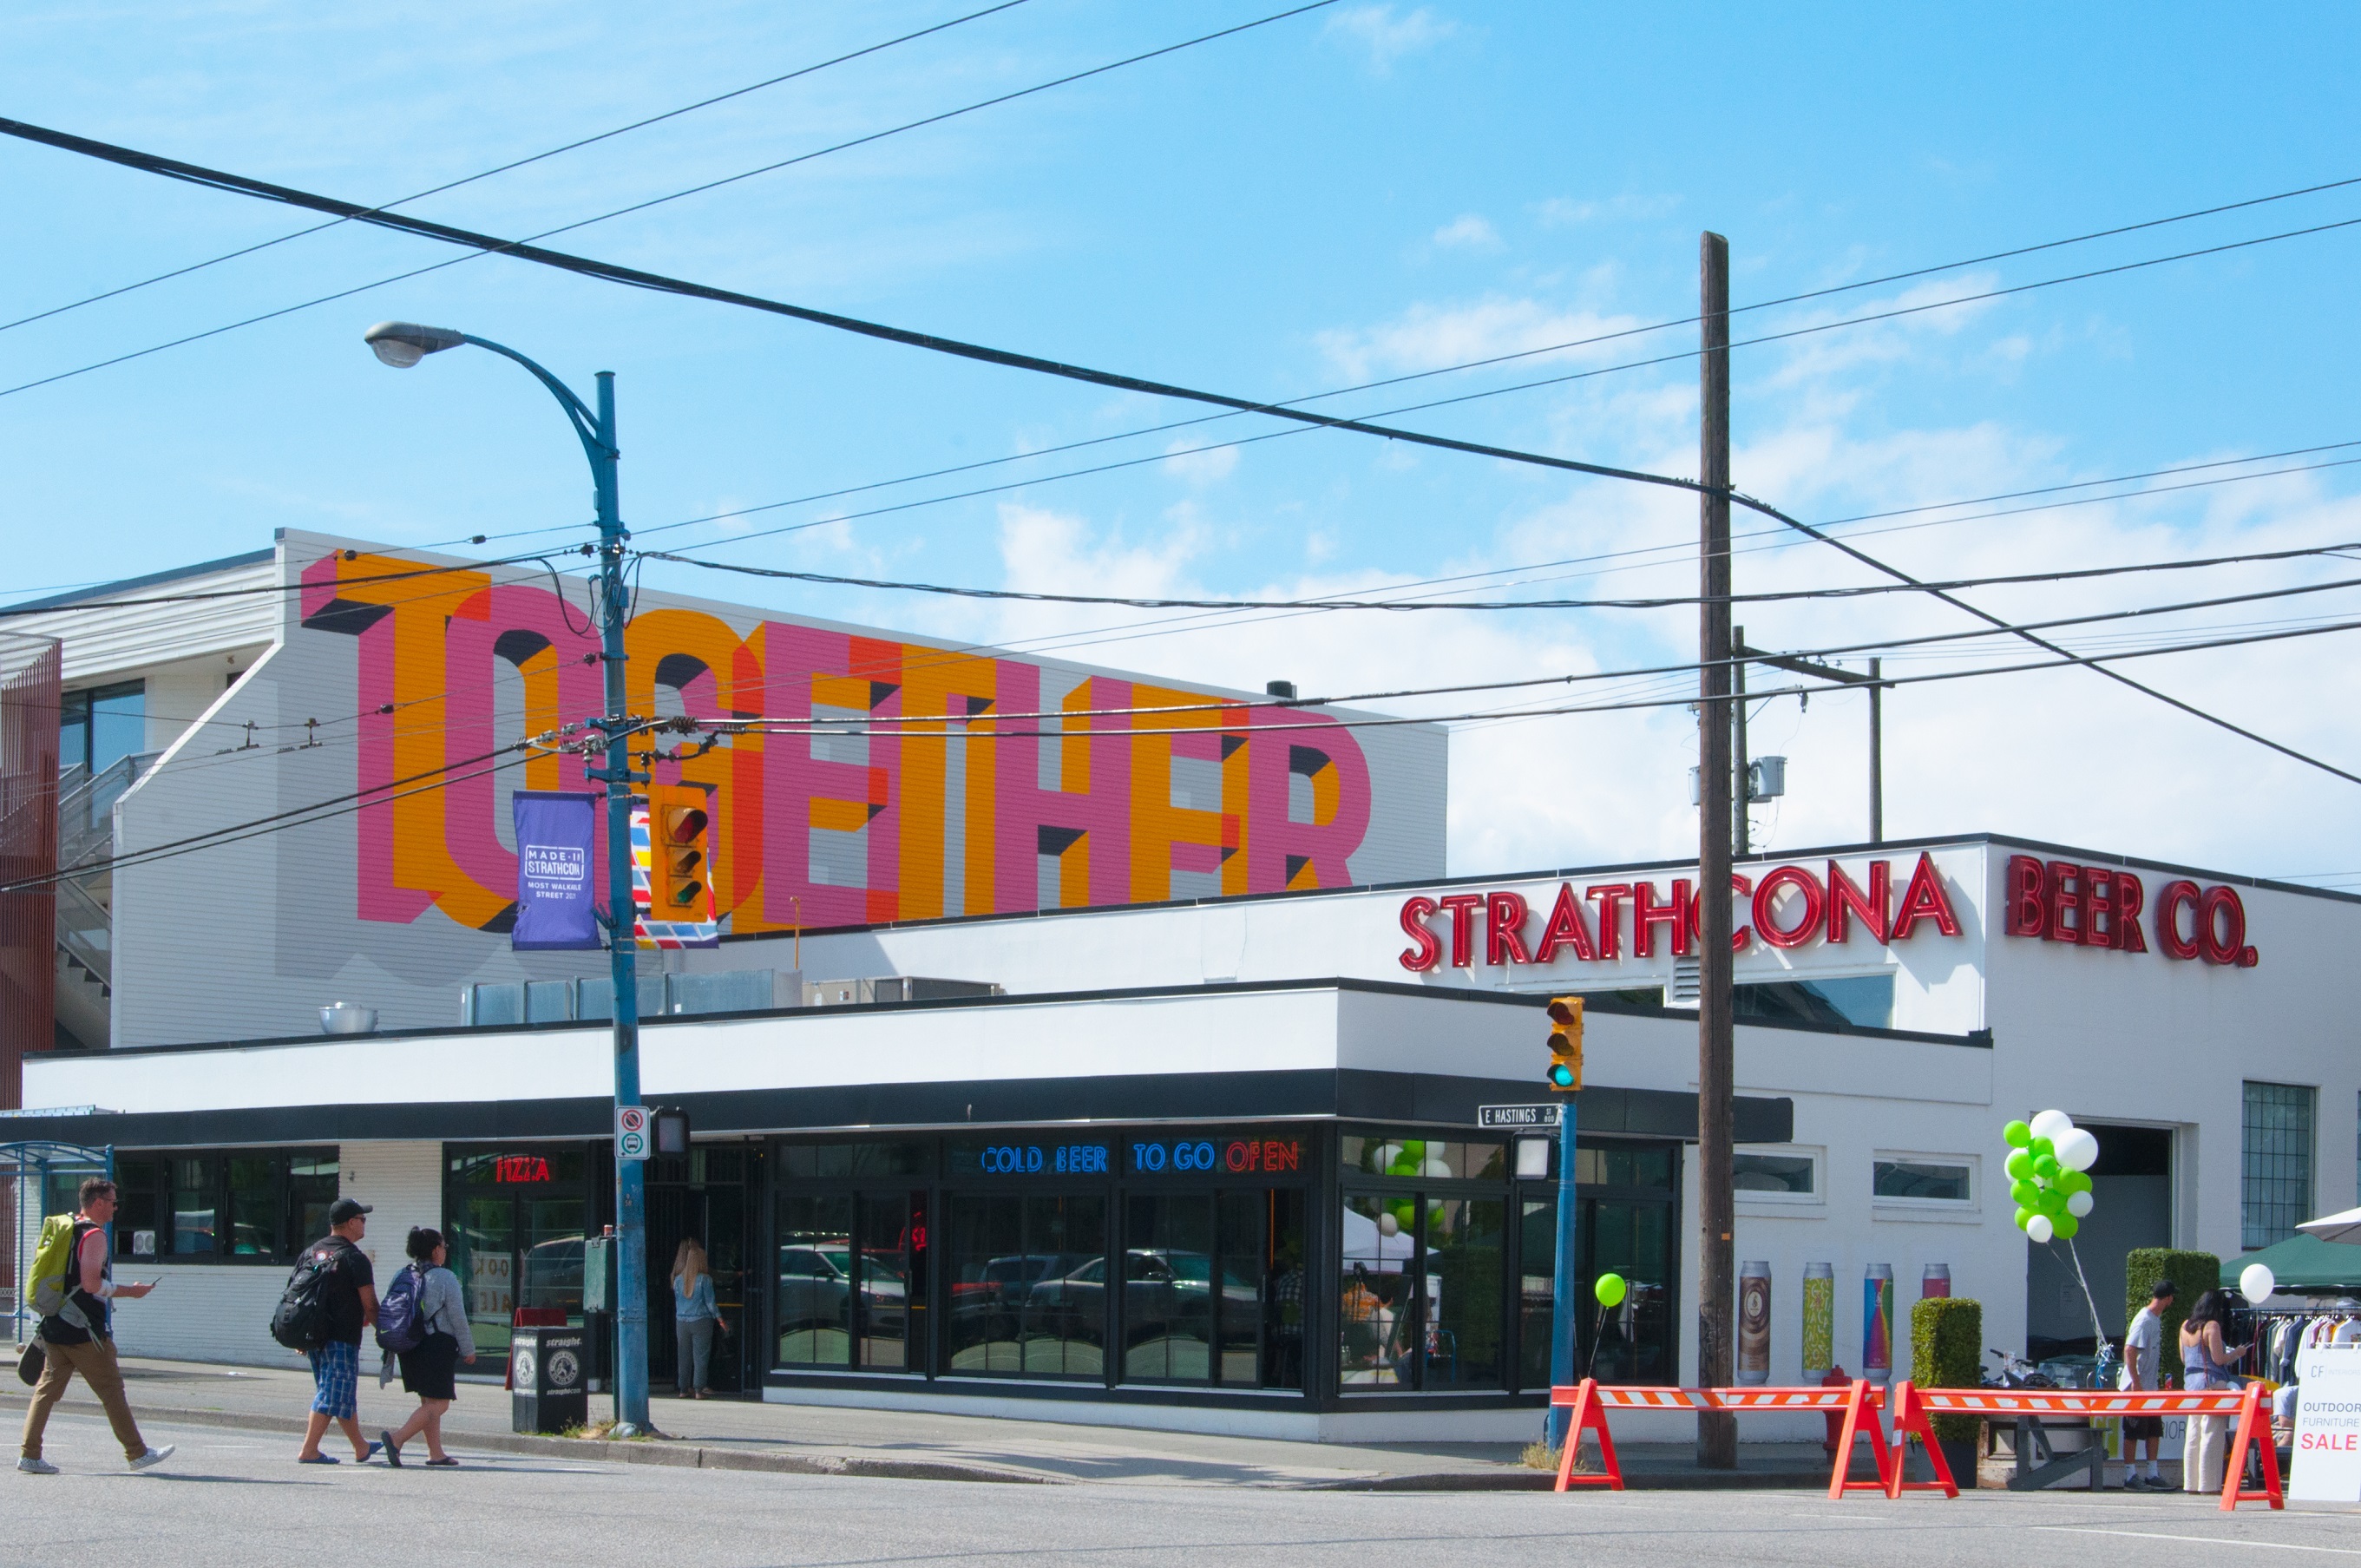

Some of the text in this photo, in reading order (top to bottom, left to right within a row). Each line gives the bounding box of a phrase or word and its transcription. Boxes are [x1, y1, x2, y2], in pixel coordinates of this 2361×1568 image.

[301, 548, 1373, 935] TOGETHER
[528, 850, 566, 861] MADE
[2005, 855, 2259, 968] BEER CO.
[1485, 1110, 1491, 1124] E
[1495, 1108, 1537, 1124] HASTINGS
[981, 1142, 1215, 1172] COLD BEER TO GO
[1226, 1141, 1297, 1171] OPEN
[495, 1157, 550, 1182] PIZZA
[2311, 1365, 2325, 1378] CF
[2304, 1402, 2361, 1413] OUTDOOR
[2302, 1417, 2360, 1427] FURNITURE
[2300, 1433, 2358, 1450] SALE
